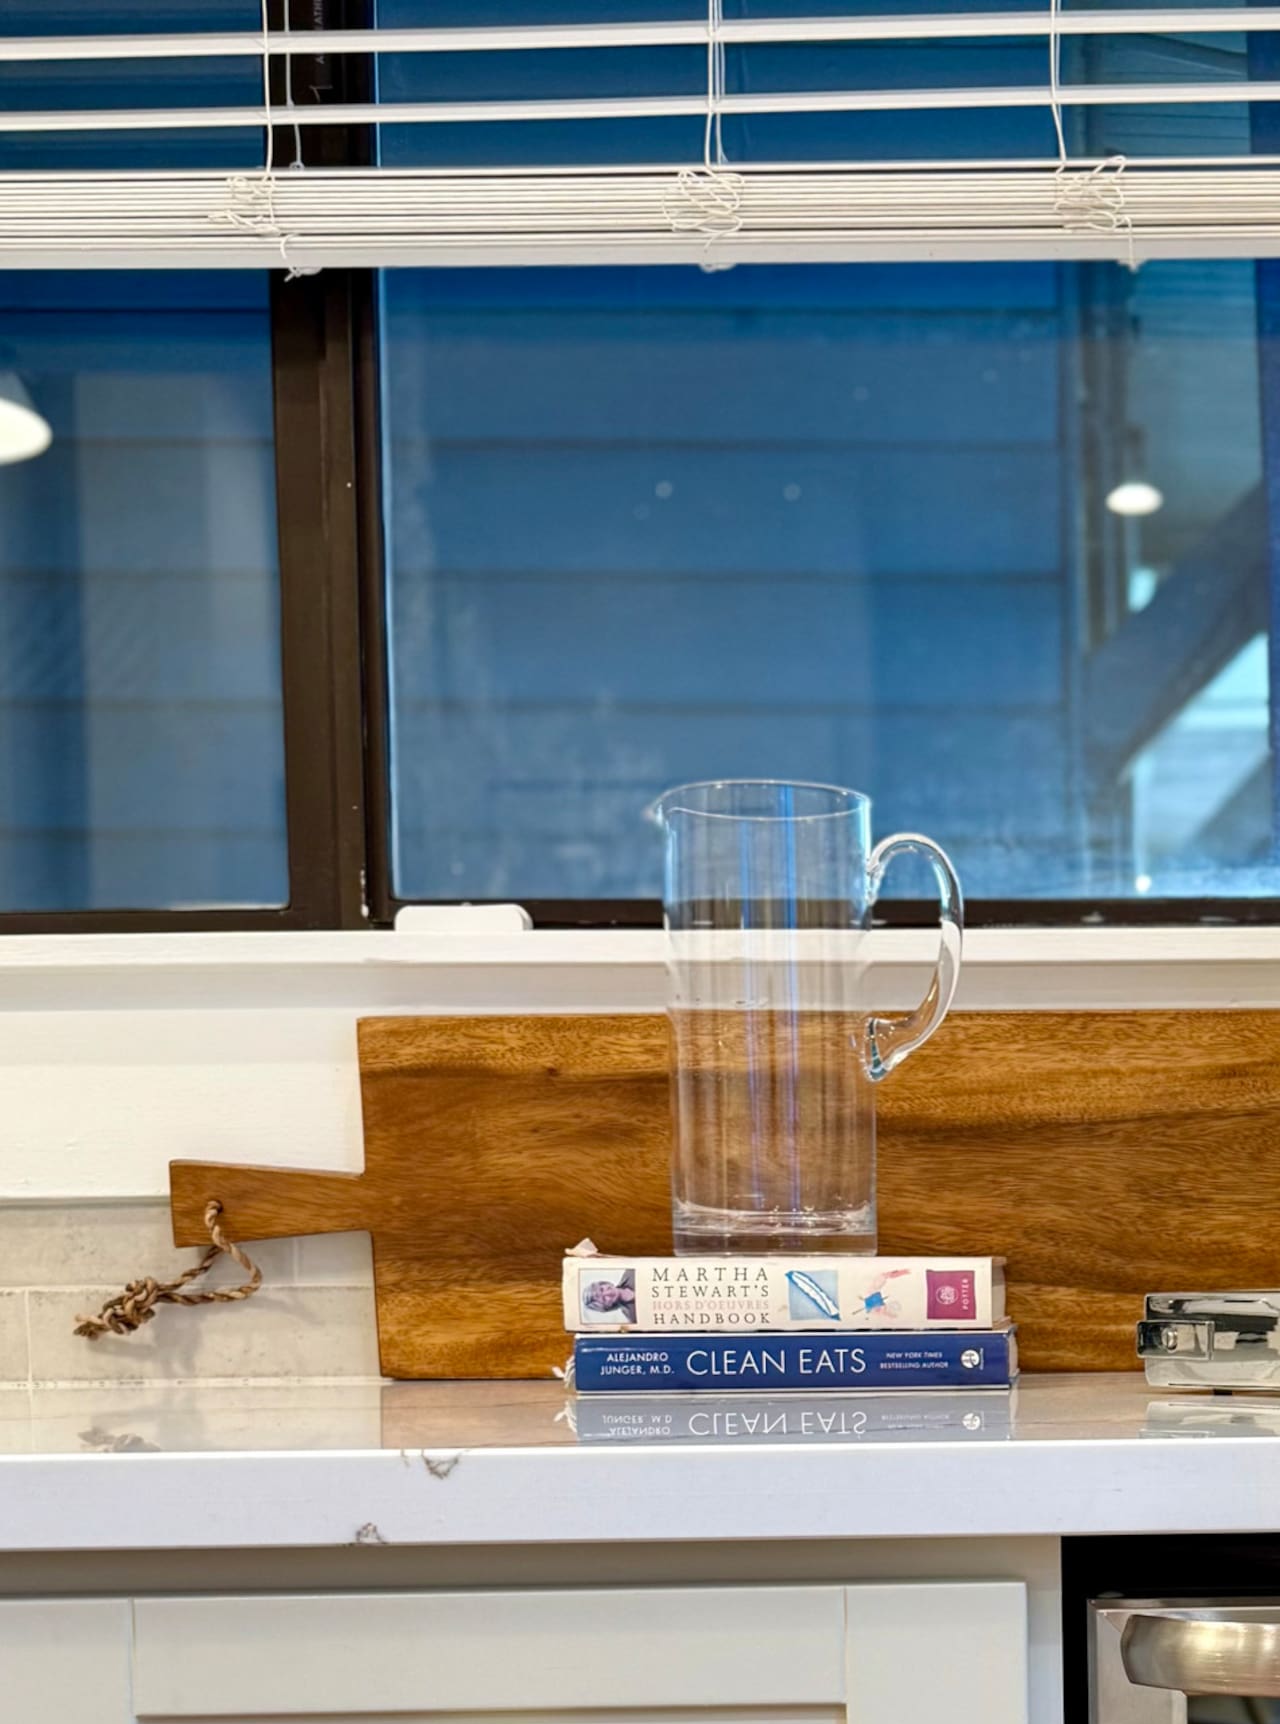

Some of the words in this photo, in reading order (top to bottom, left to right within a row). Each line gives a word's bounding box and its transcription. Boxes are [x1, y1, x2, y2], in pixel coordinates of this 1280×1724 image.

[651, 1267, 769, 1282] MARTHA
[651, 1285, 769, 1298] STEWART'S
[652, 1300, 690, 1311] HORS
[654, 1312, 770, 1325] HANDBOOK
[606, 1352, 669, 1363] ALEJANDRO
[924, 1351, 943, 1359] TIMES
[686, 1350, 786, 1377] CLEAN
[799, 1348, 867, 1375] EATS
[879, 1362, 921, 1370] BESTSELLING
[922, 1361, 949, 1369] AUTHOR
[600, 1365, 646, 1376] JUNGER,
[649, 1365, 675, 1375] M.D.
